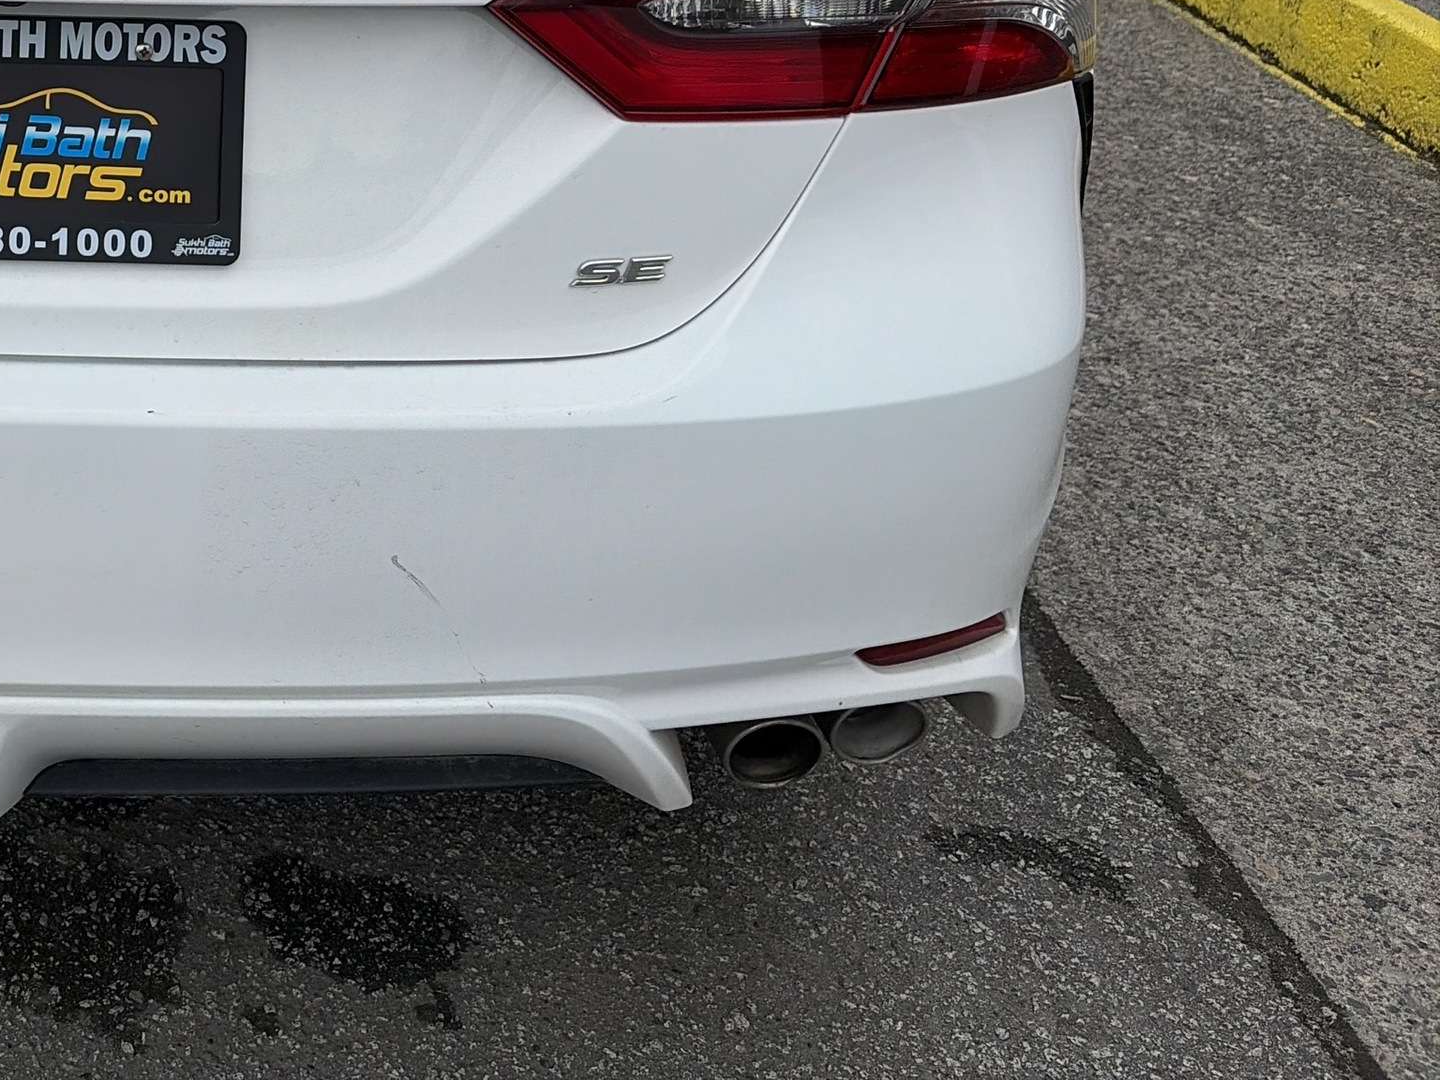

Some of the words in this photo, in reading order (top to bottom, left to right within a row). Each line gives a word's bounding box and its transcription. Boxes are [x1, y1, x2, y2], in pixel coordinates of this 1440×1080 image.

[61, 21, 227, 65] MOTORS
[24, 113, 153, 160] Bath
[568, 254, 674, 288] SE
